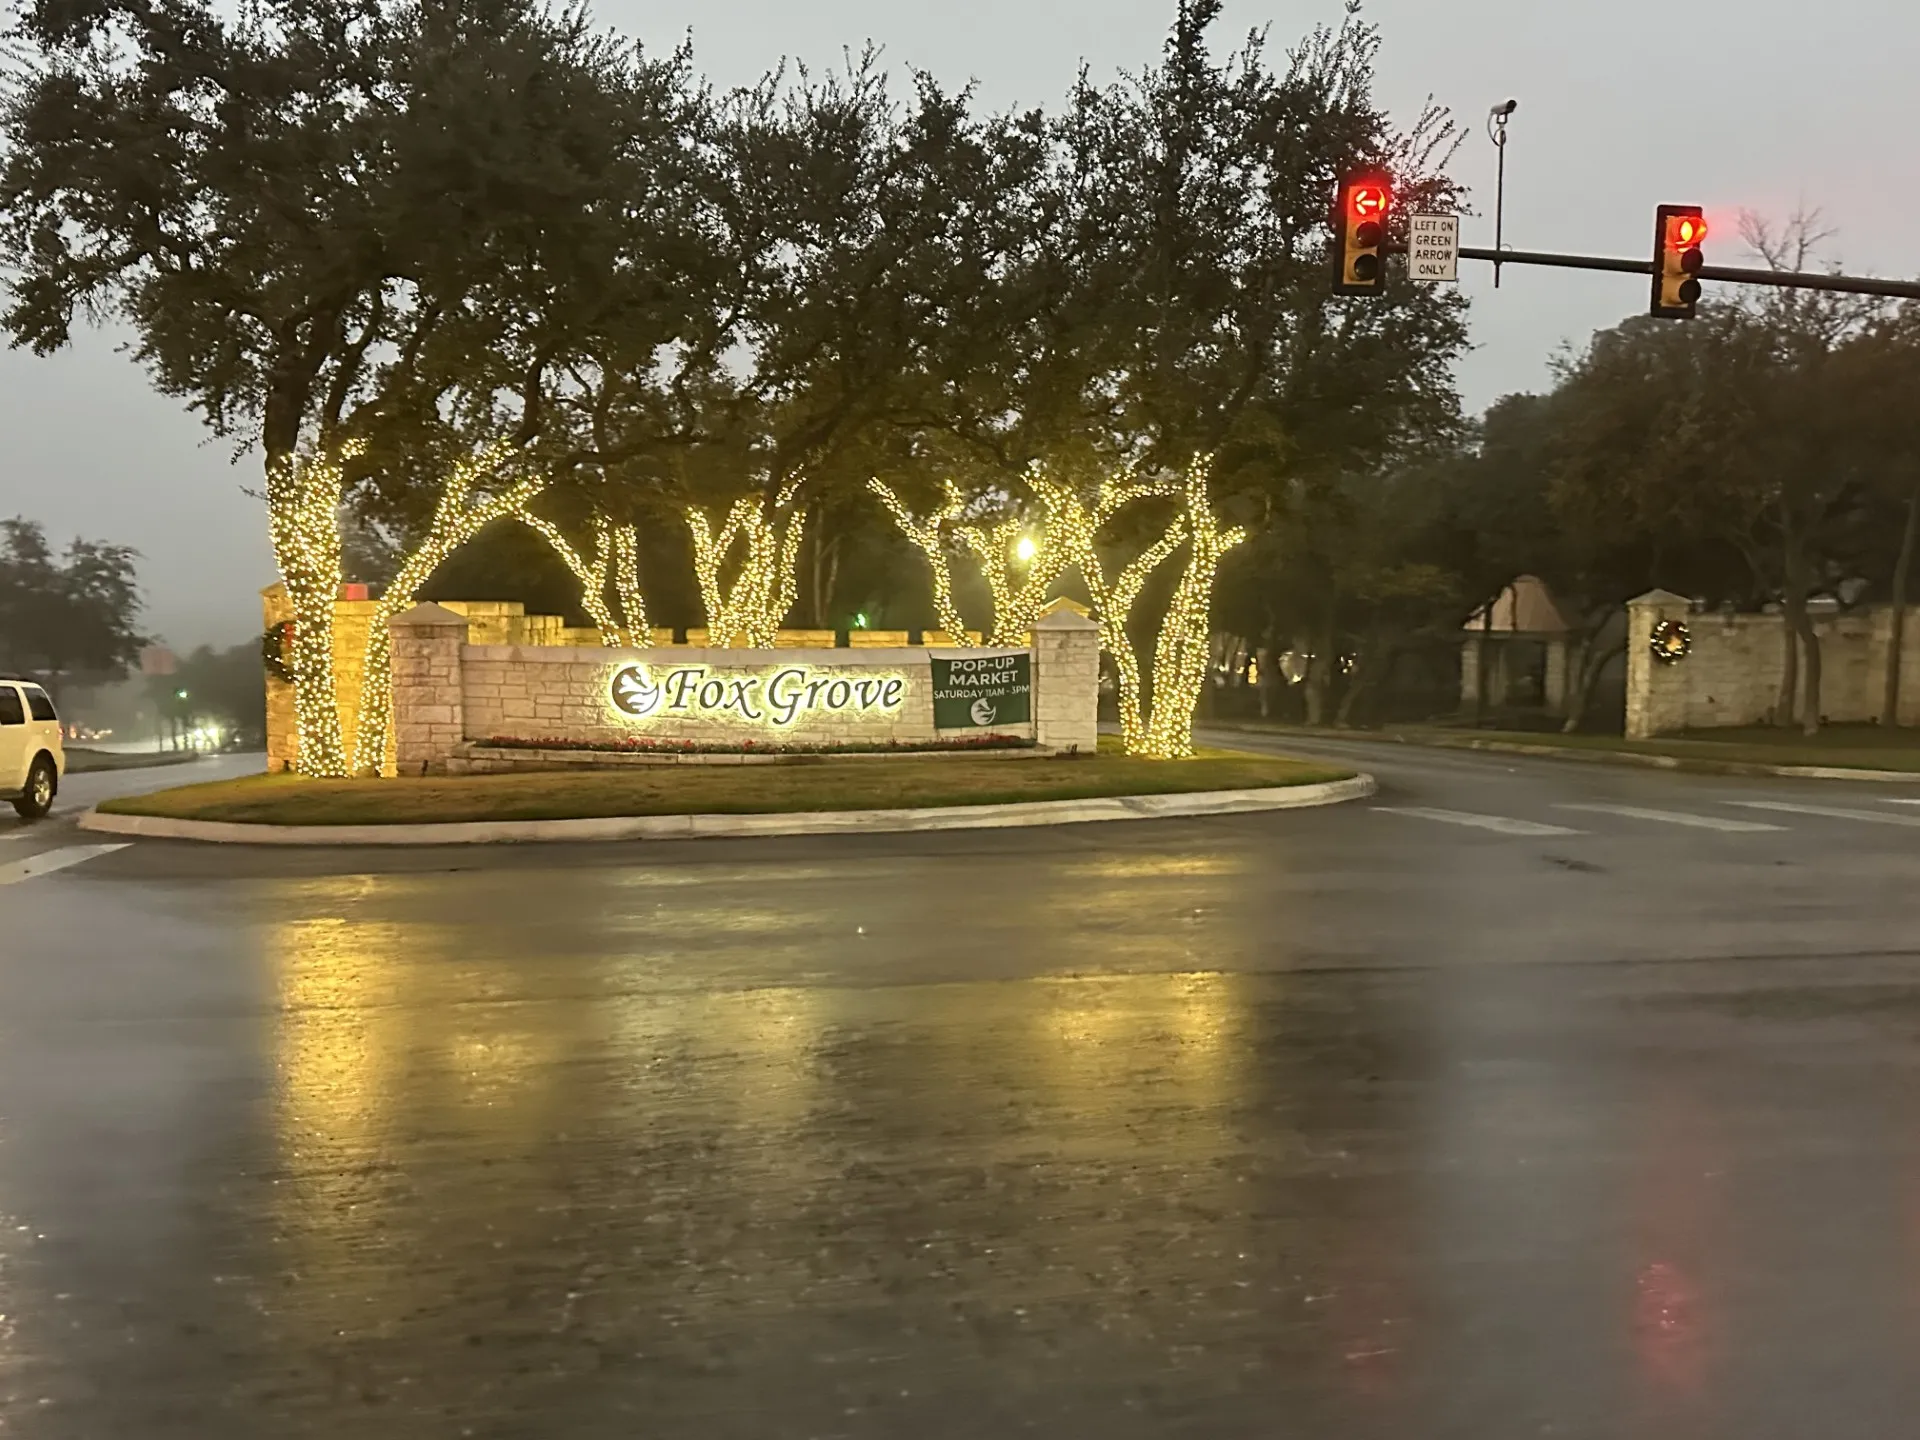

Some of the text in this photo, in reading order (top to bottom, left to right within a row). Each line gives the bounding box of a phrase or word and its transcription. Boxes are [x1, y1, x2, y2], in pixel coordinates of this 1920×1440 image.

[1415, 221, 1453, 231] LEFT ON
[1416, 235, 1451, 246] GREEN
[1415, 249, 1452, 260] ARROW
[1419, 264, 1446, 275] ONLY
[950, 657, 1015, 672] POP-UP
[949, 670, 1018, 686] MARKET
[665, 669, 903, 726] Fox Grove
[934, 689, 983, 699] SATURDAY
[985, 687, 1005, 697] 11AM
[1011, 684, 1030, 695] 3PM
